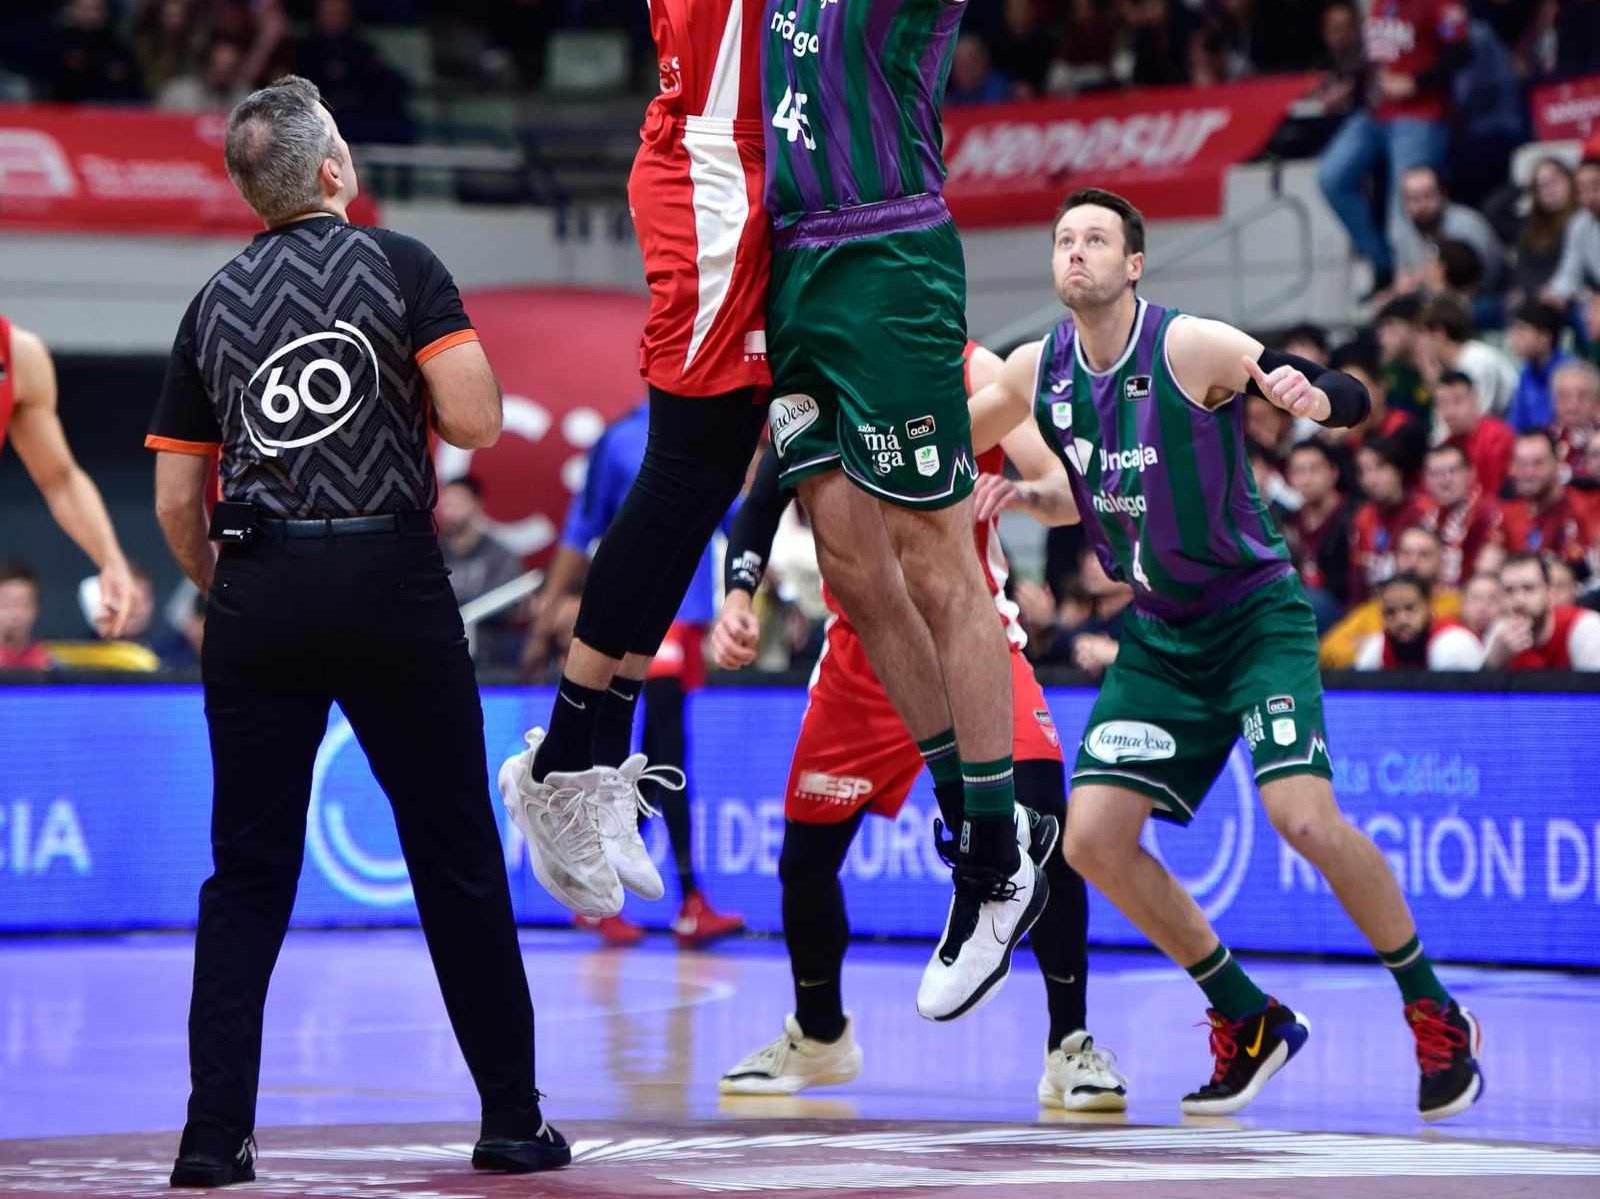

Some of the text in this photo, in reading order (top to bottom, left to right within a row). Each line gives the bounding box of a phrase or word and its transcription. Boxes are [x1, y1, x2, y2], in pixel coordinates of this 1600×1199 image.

[261, 358, 351, 423] 60
[772, 399, 815, 433] adesa
[910, 424, 930, 436] acb
[0, 799, 92, 877] IA
[1546, 817, 1600, 903] D
